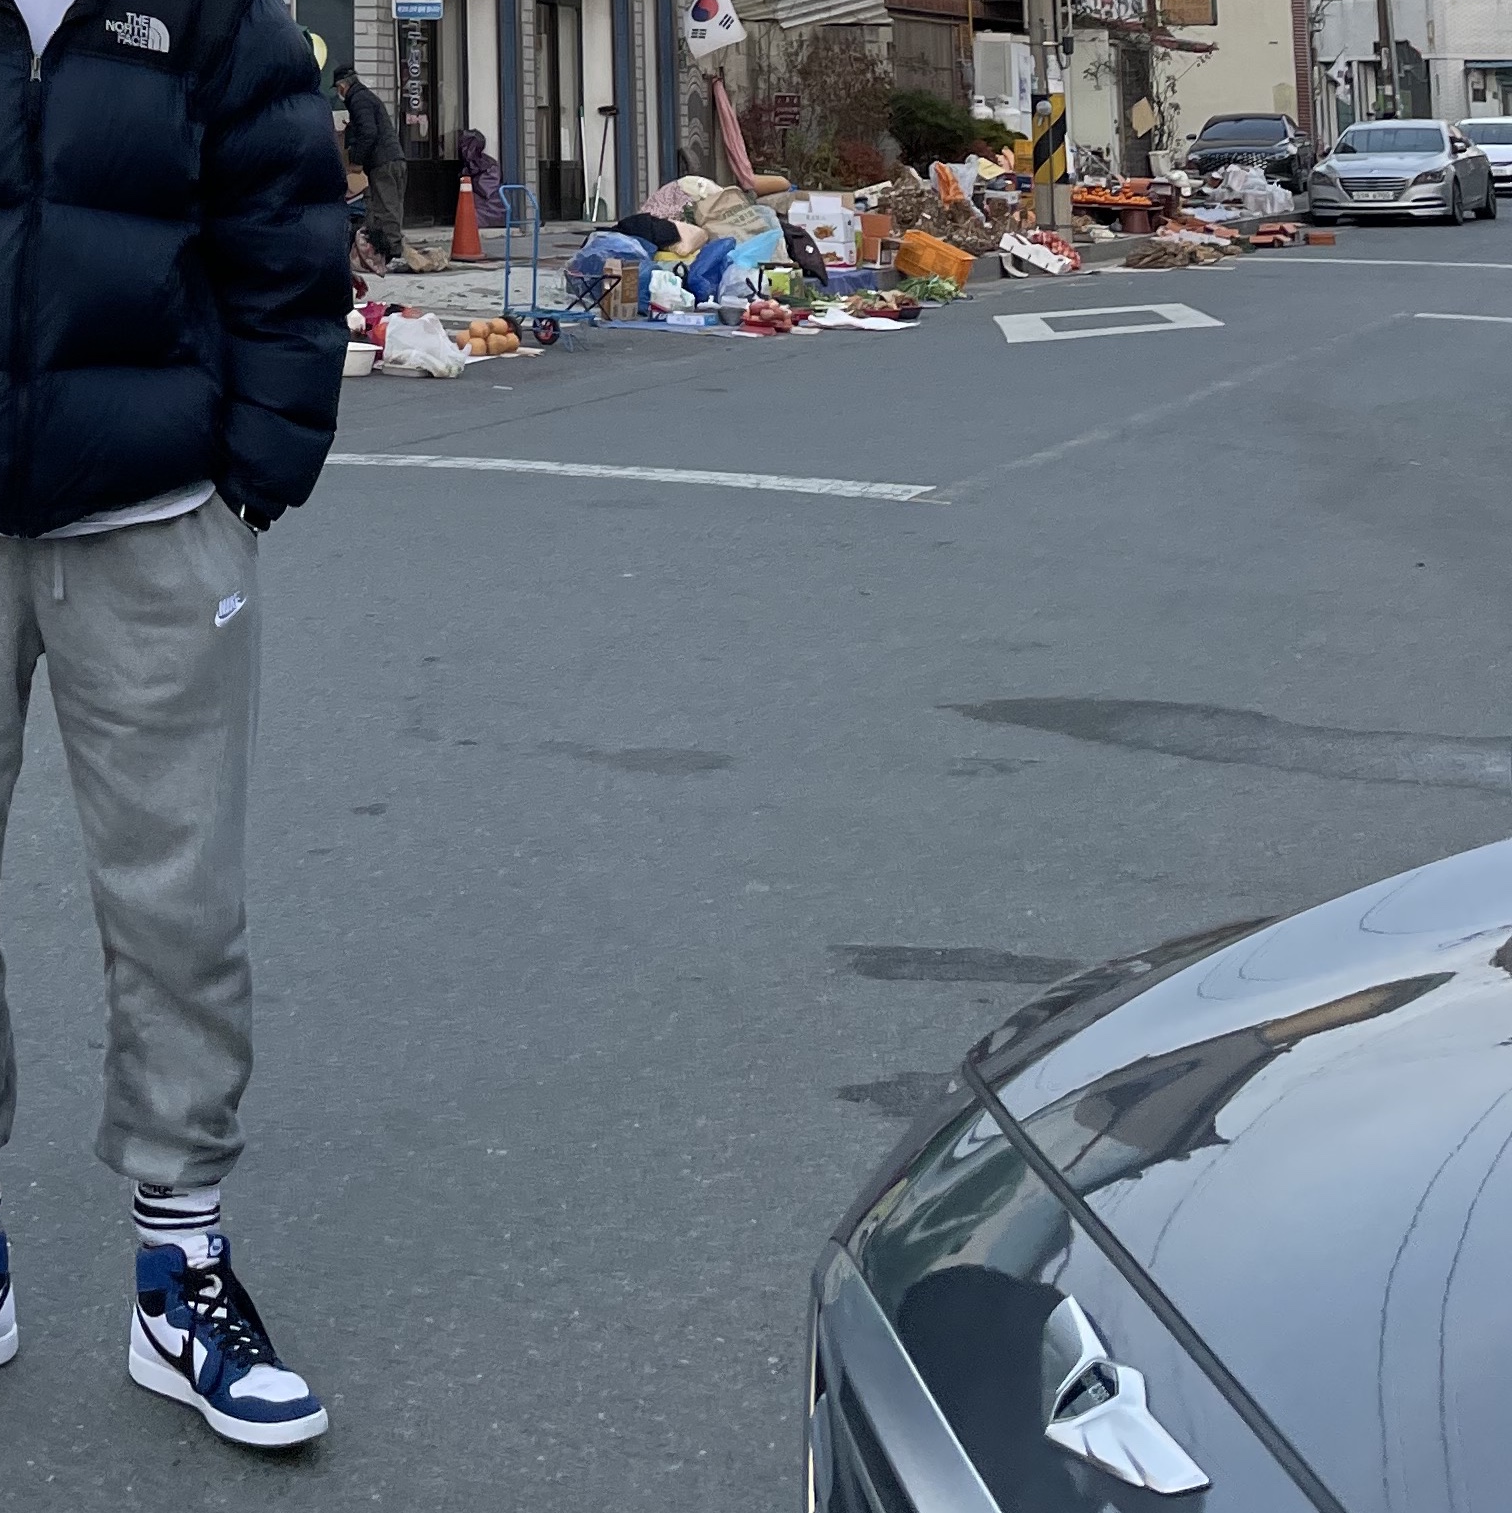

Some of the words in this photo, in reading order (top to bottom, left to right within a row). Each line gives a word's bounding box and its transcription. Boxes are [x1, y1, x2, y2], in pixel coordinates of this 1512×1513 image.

[125, 12, 150, 27] THE
[105, 19, 149, 39] NORTH
[117, 32, 148, 49] FACE
